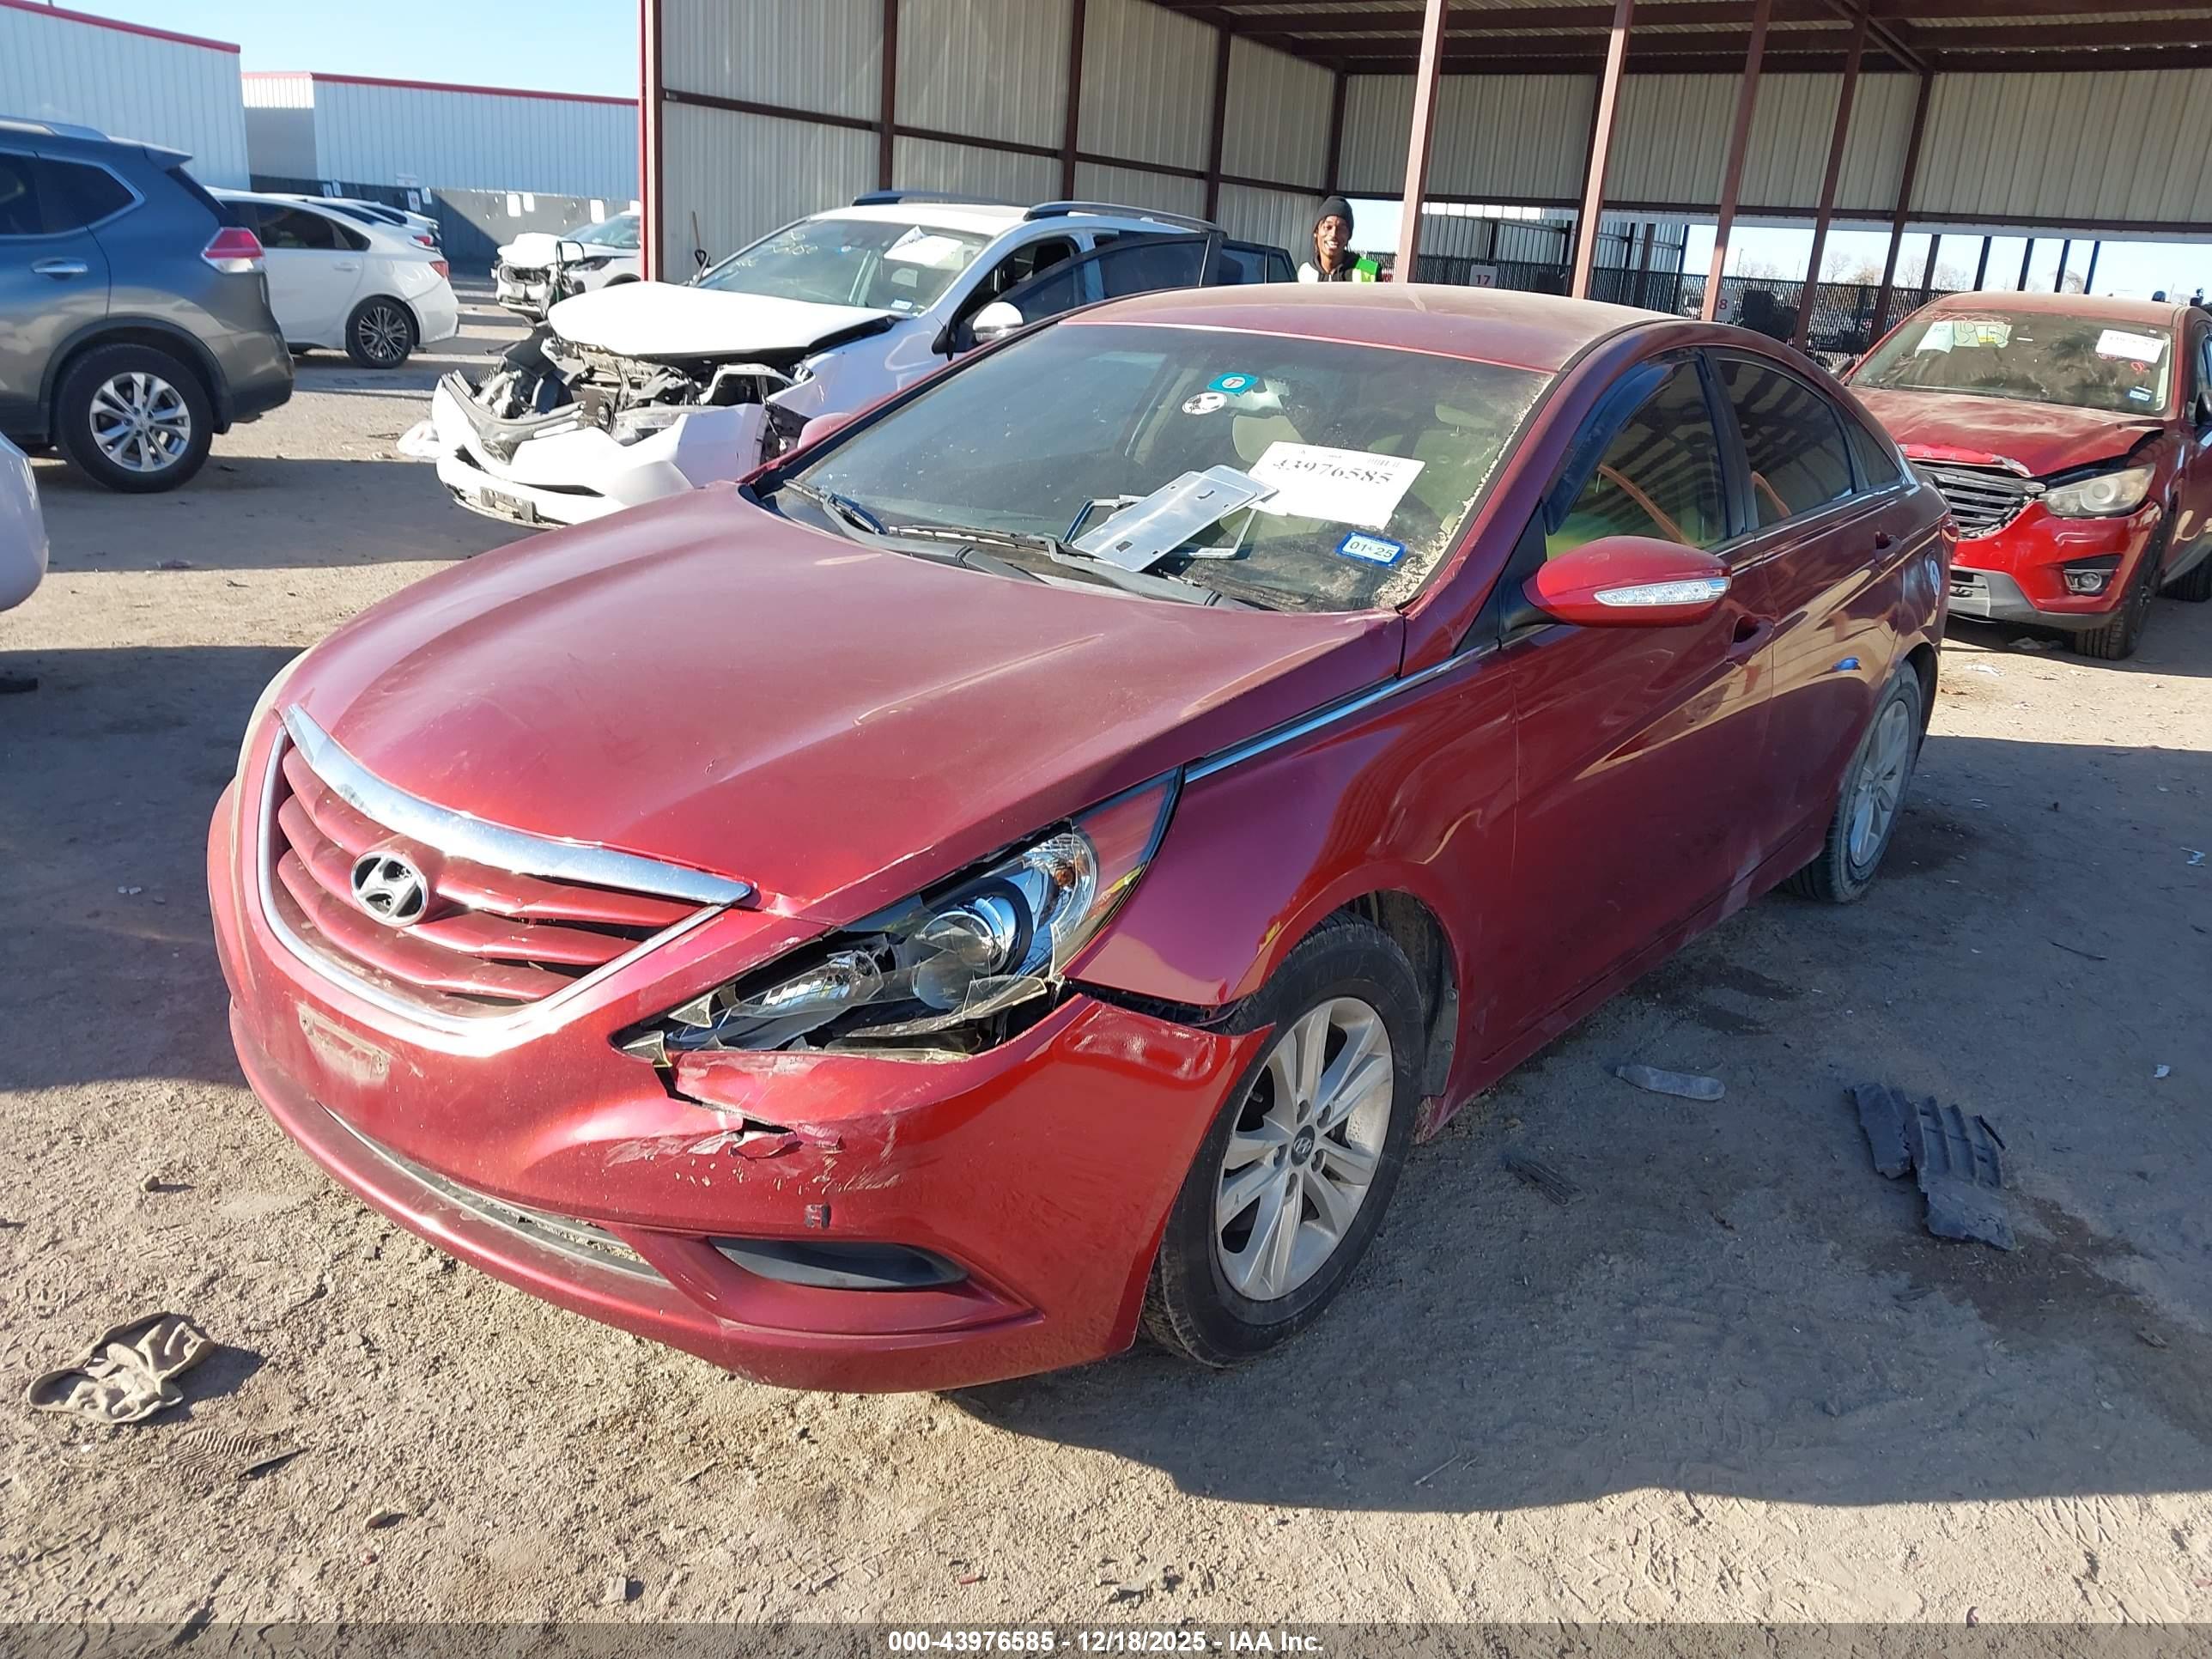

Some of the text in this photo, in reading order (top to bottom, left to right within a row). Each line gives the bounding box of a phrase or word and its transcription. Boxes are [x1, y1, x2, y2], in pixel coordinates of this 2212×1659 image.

[1475, 274, 1491, 285] 17
[1718, 299, 1728, 310] 8
[1373, 547, 1395, 558] 25
